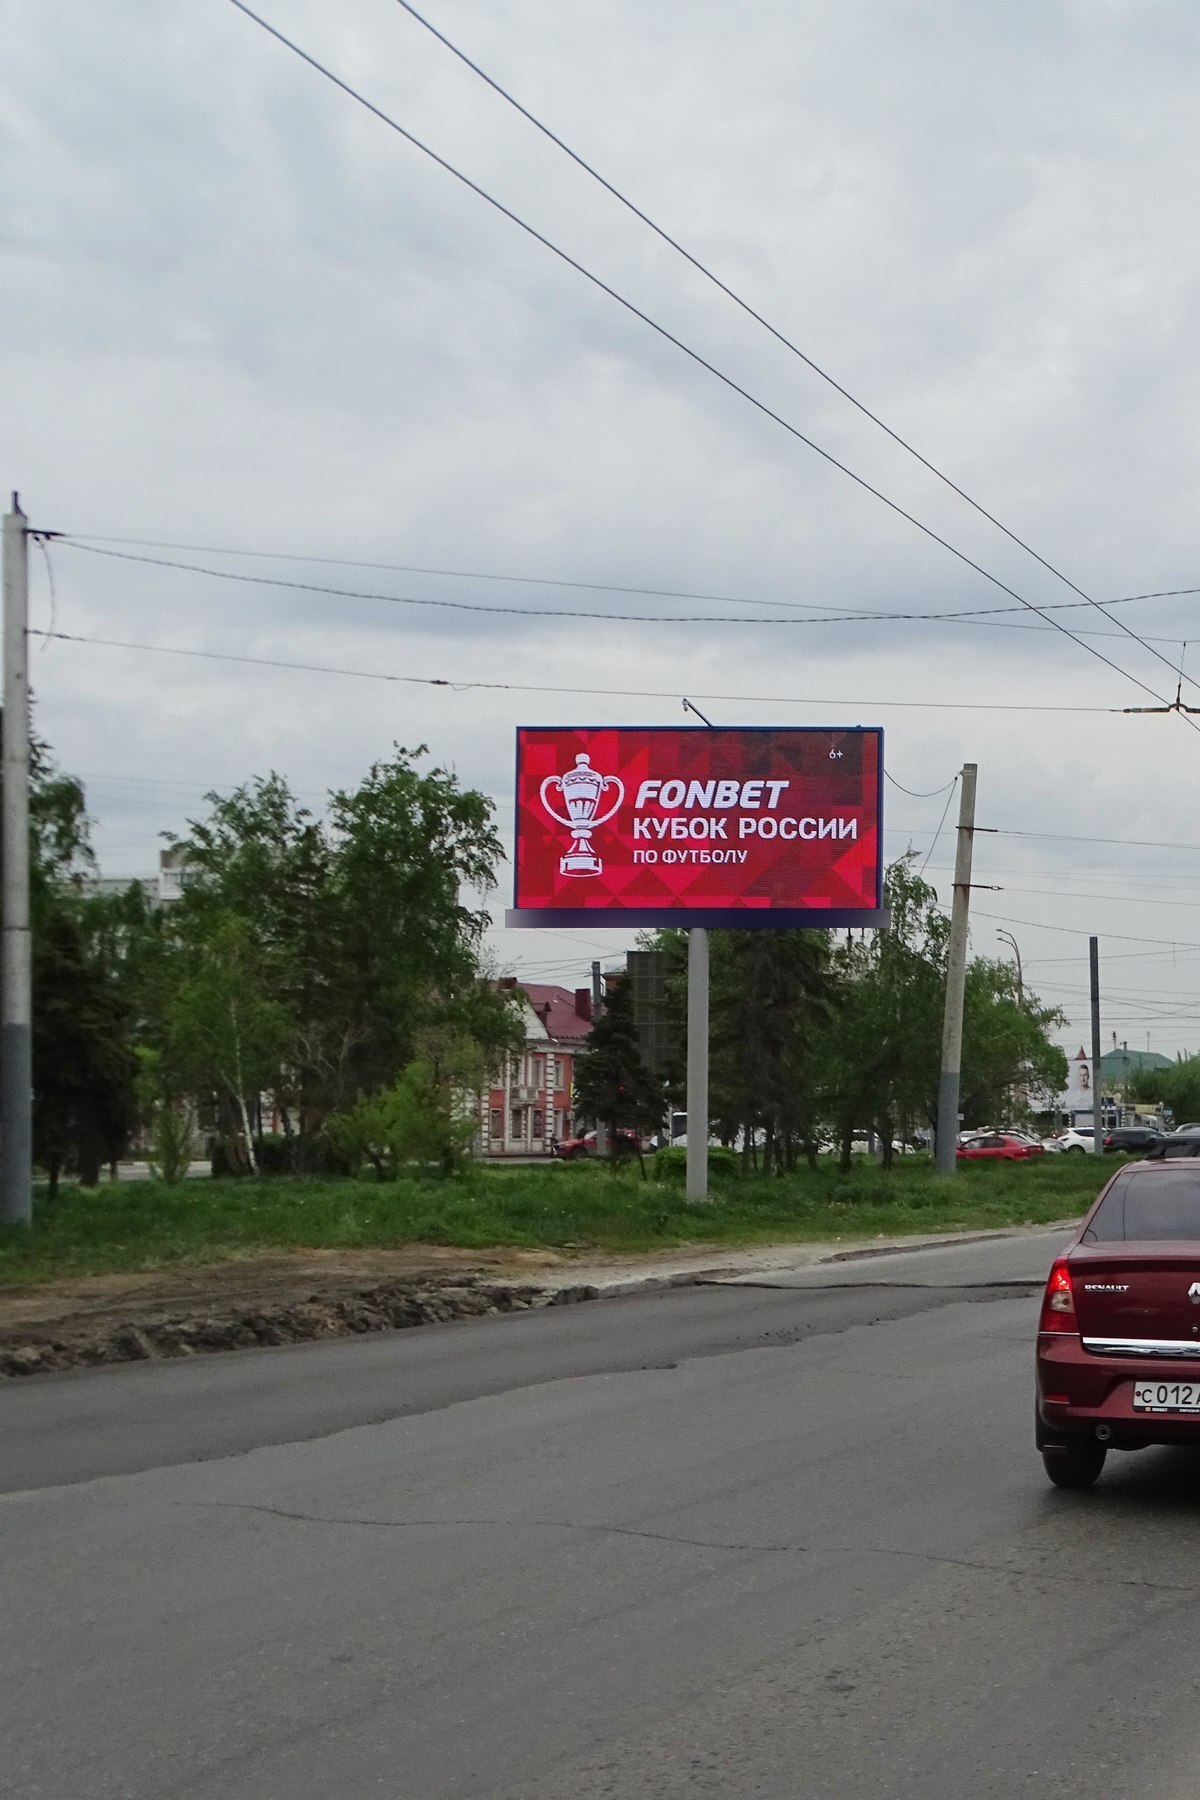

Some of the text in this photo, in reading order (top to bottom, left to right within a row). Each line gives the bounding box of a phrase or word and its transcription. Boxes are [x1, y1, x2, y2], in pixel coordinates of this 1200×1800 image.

[828, 748, 844, 760] 6+
[634, 779, 790, 809] FONBET
[633, 817, 858, 840] КУБОК РОССИИ
[633, 849, 748, 865] ПО ФУТБОЛУ
